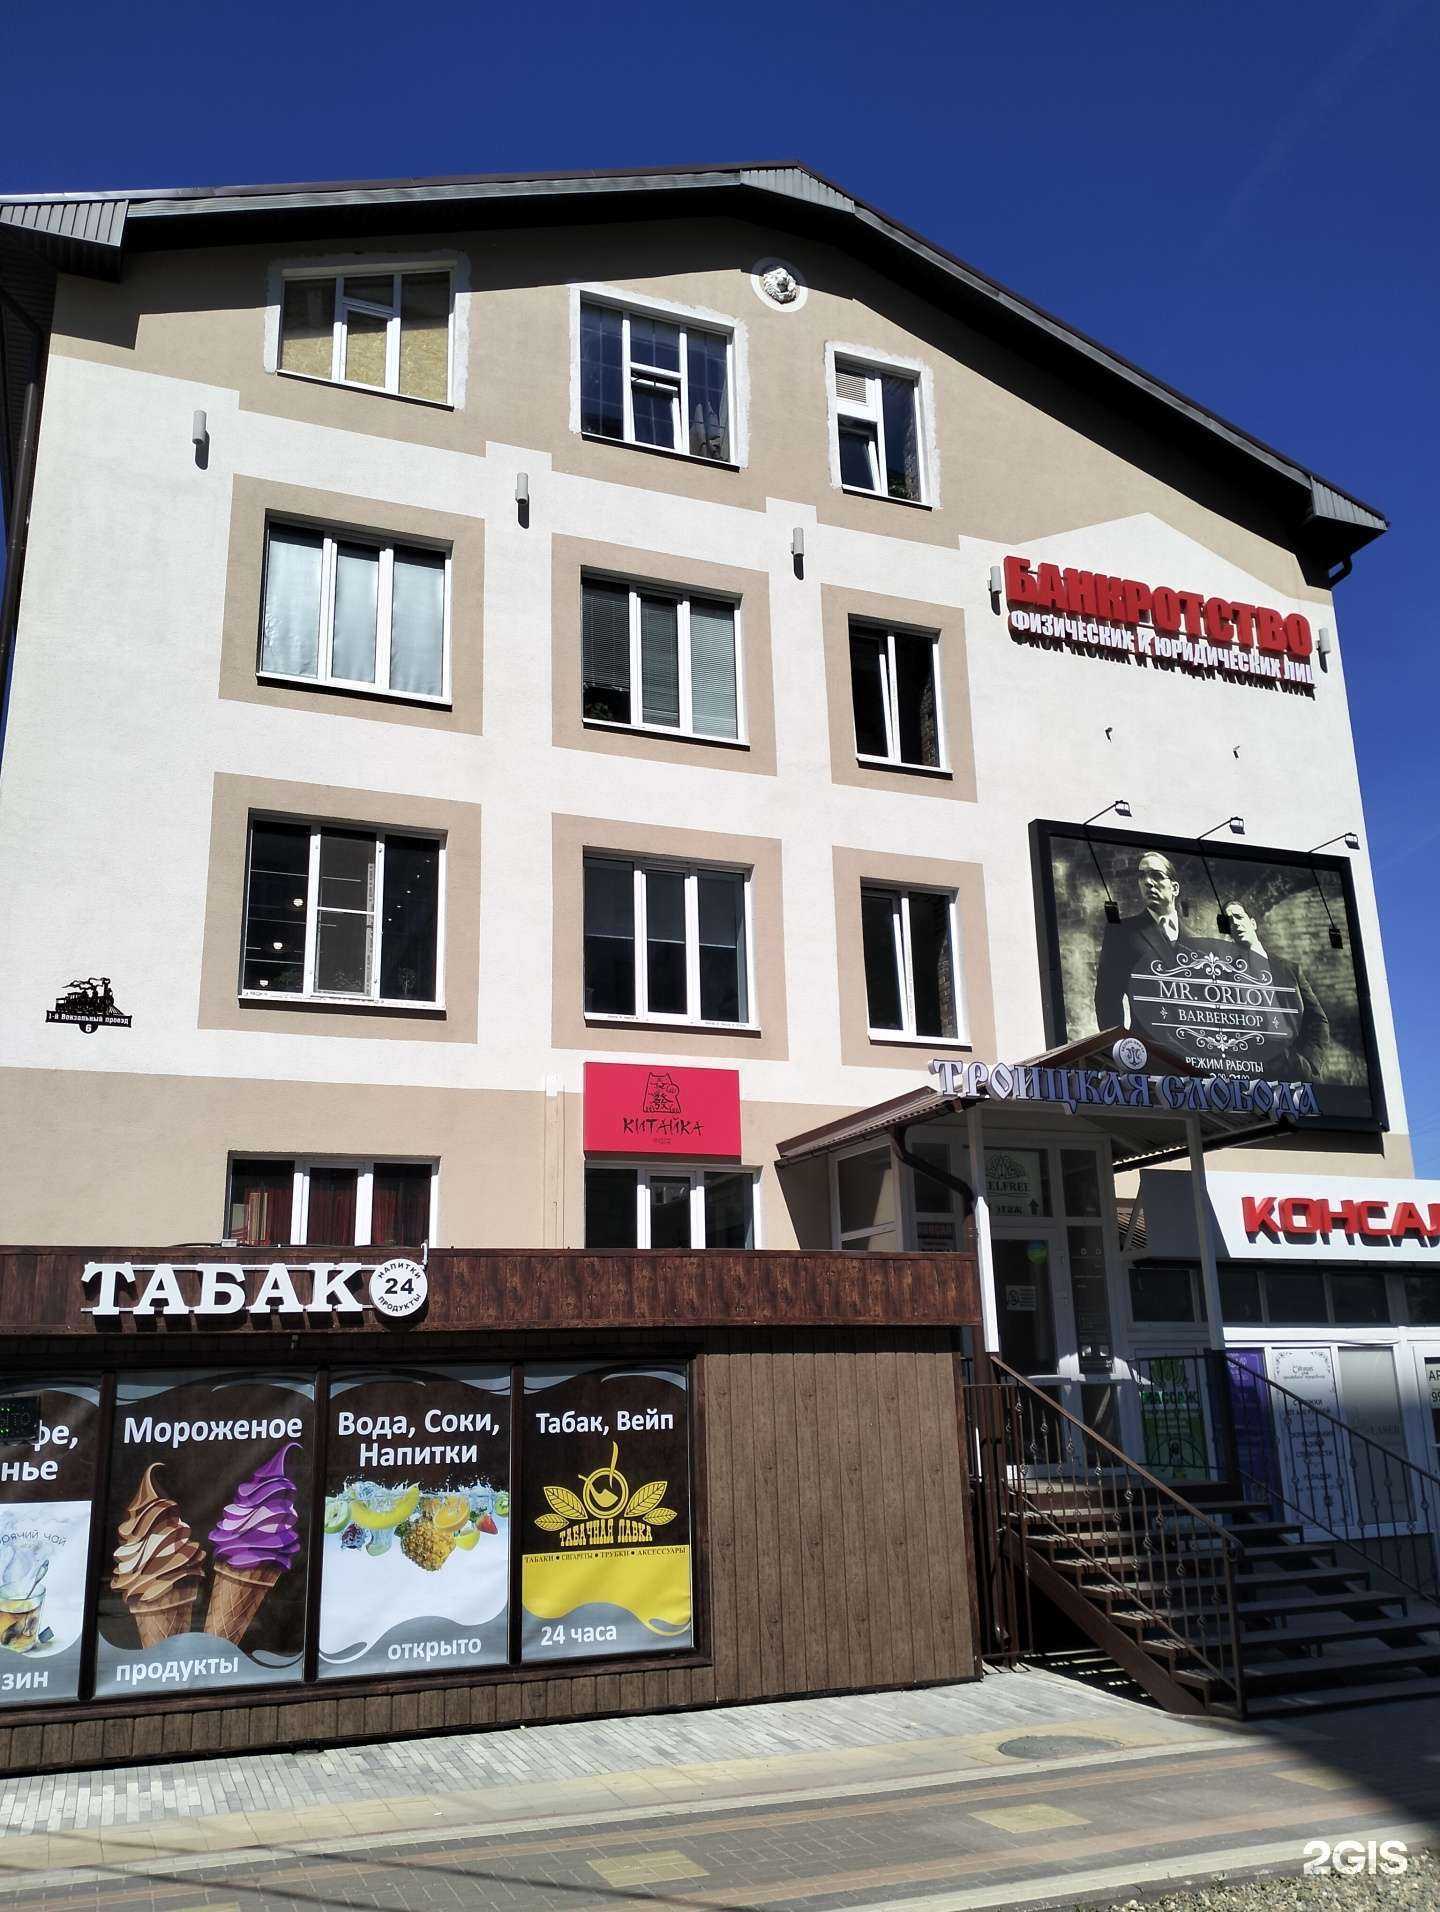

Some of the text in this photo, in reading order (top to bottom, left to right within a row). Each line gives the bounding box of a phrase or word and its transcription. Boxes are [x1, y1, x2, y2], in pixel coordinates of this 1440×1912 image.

[1003, 555, 1314, 657] БАНКРОТСТВО
[1010, 609, 1134, 650] ФИЗИЧЕСКИХ
[1155, 635, 1281, 679] ЮРИДИЧЕСКИХ
[1159, 980, 1276, 1006] MR. ORLOV
[85, 1023, 92, 1033] 6
[1178, 1008, 1263, 1027] BARBERSHOP
[1185, 1056, 1264, 1073] РЕЖИМ РАБОТЫ
[930, 1058, 1323, 1121] ТРОИЦКАЯ СЛОБОДА
[623, 1116, 704, 1136] КИТАЙКА
[378, 1262, 422, 1279] НАПИТКИ
[81, 1262, 363, 1315] ТАБАК
[384, 1278, 414, 1295] 24
[378, 1293, 422, 1312] ПРОДУКТЫ
[123, 1417, 302, 1449] Мороженое
[338, 1408, 500, 1440] Вода, Соки,
[536, 1408, 674, 1435] Табак, Вейп
[359, 1443, 478, 1467] Напитки
[559, 1518, 653, 1547] ТАБАЧНАЯ ЛАВКА
[541, 1622, 617, 1646] 24 часа
[387, 1636, 482, 1662] открыто
[116, 1656, 239, 1685] продукты
